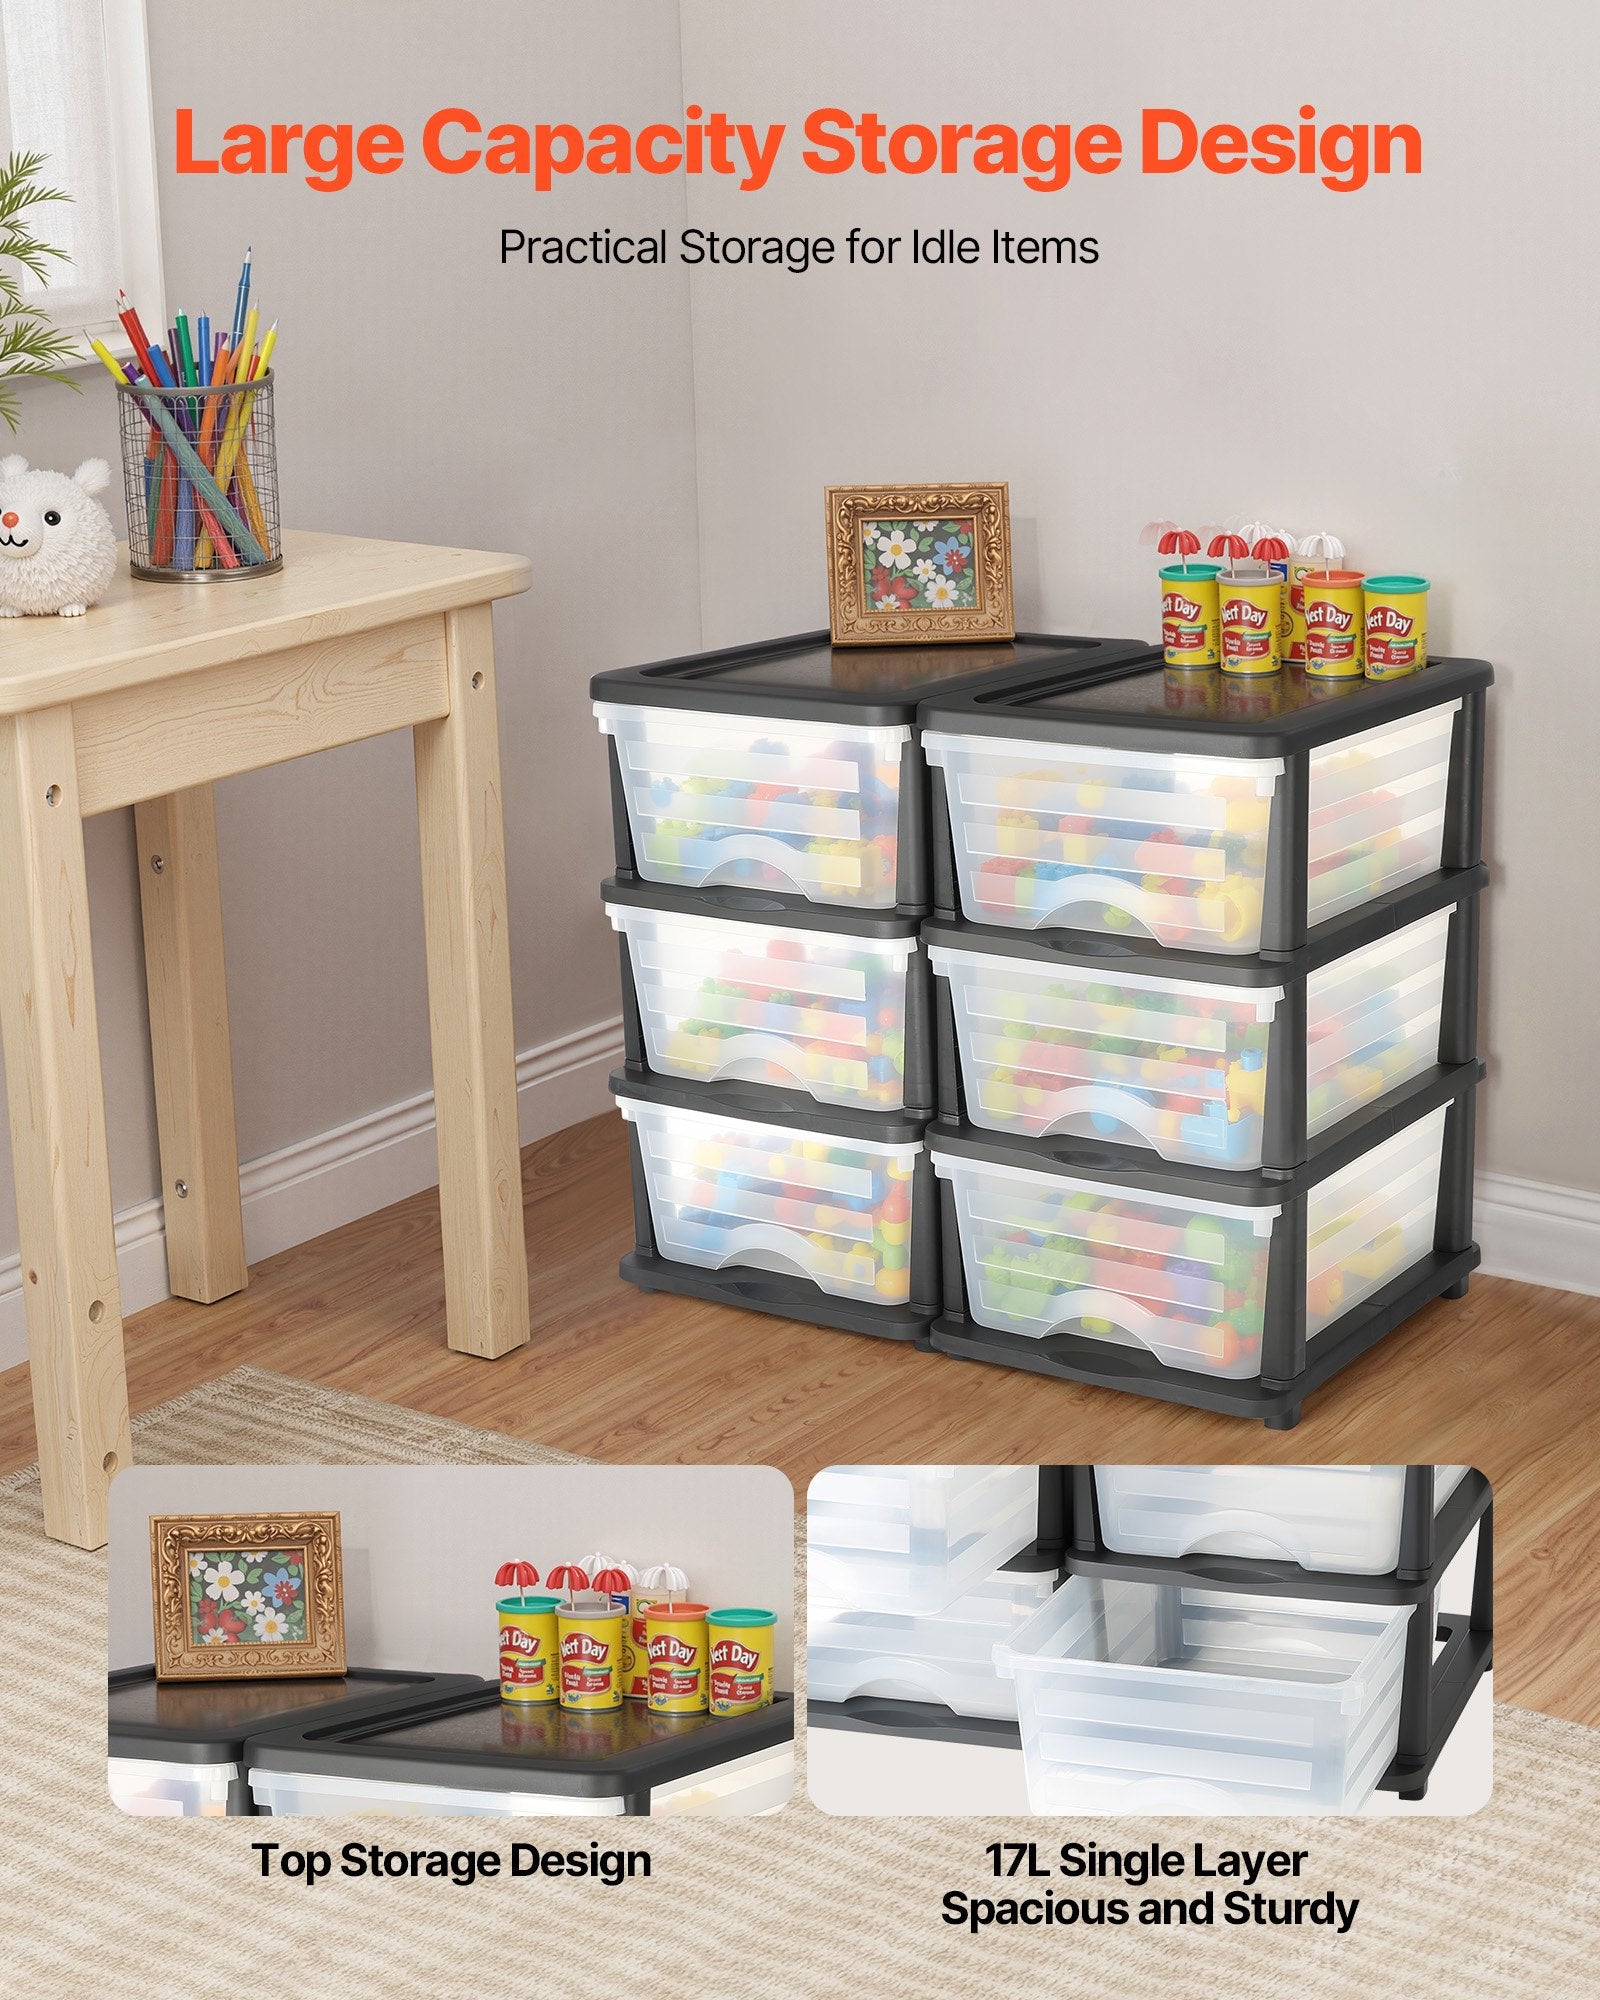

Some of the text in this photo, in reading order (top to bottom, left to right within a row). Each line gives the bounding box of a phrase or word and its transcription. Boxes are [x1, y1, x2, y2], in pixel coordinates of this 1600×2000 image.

[1175, 596, 1199, 619] Day
[1242, 604, 1266, 627] Day
[1326, 606, 1351, 629] Day
[1386, 611, 1411, 634] Day
[512, 1630, 537, 1653] Day
[581, 1638, 607, 1661] Day
[669, 1640, 695, 1663] Day
[731, 1645, 757, 1669] Day
